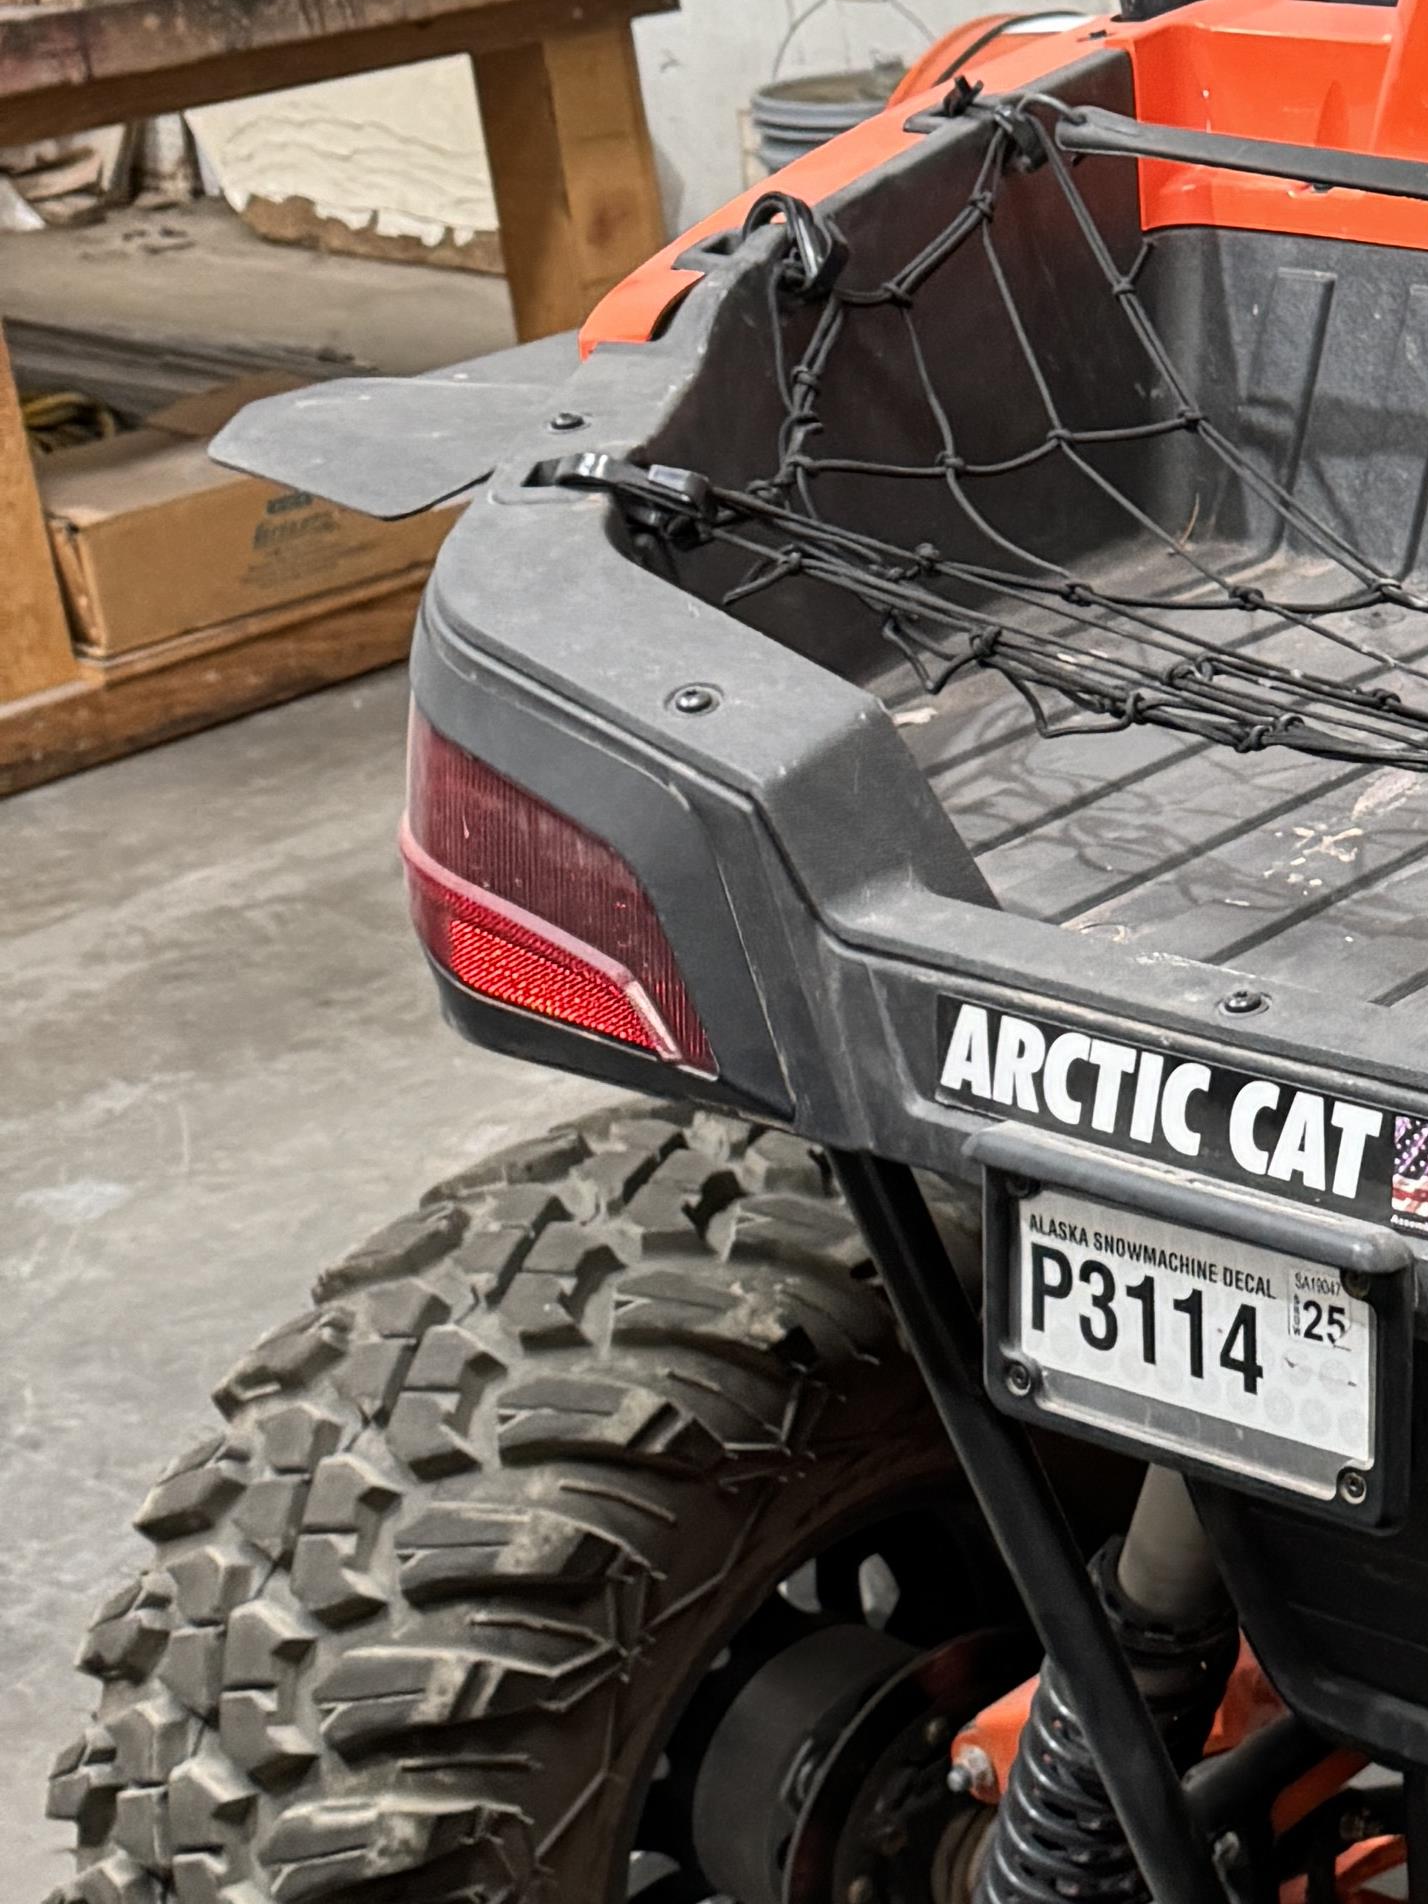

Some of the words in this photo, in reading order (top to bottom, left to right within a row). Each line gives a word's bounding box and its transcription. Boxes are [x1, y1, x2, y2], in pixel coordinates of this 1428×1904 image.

[940, 1003, 1212, 1156] ARCTIC
[1228, 1080, 1383, 1199] CAT
[1029, 1213, 1089, 1247] ALASKA
[1093, 1232, 1218, 1283] SNOWMACHINE
[1222, 1267, 1278, 1300] DECAL
[1031, 1242, 1264, 1396] P3114
[1303, 1299, 1346, 1344] 25
